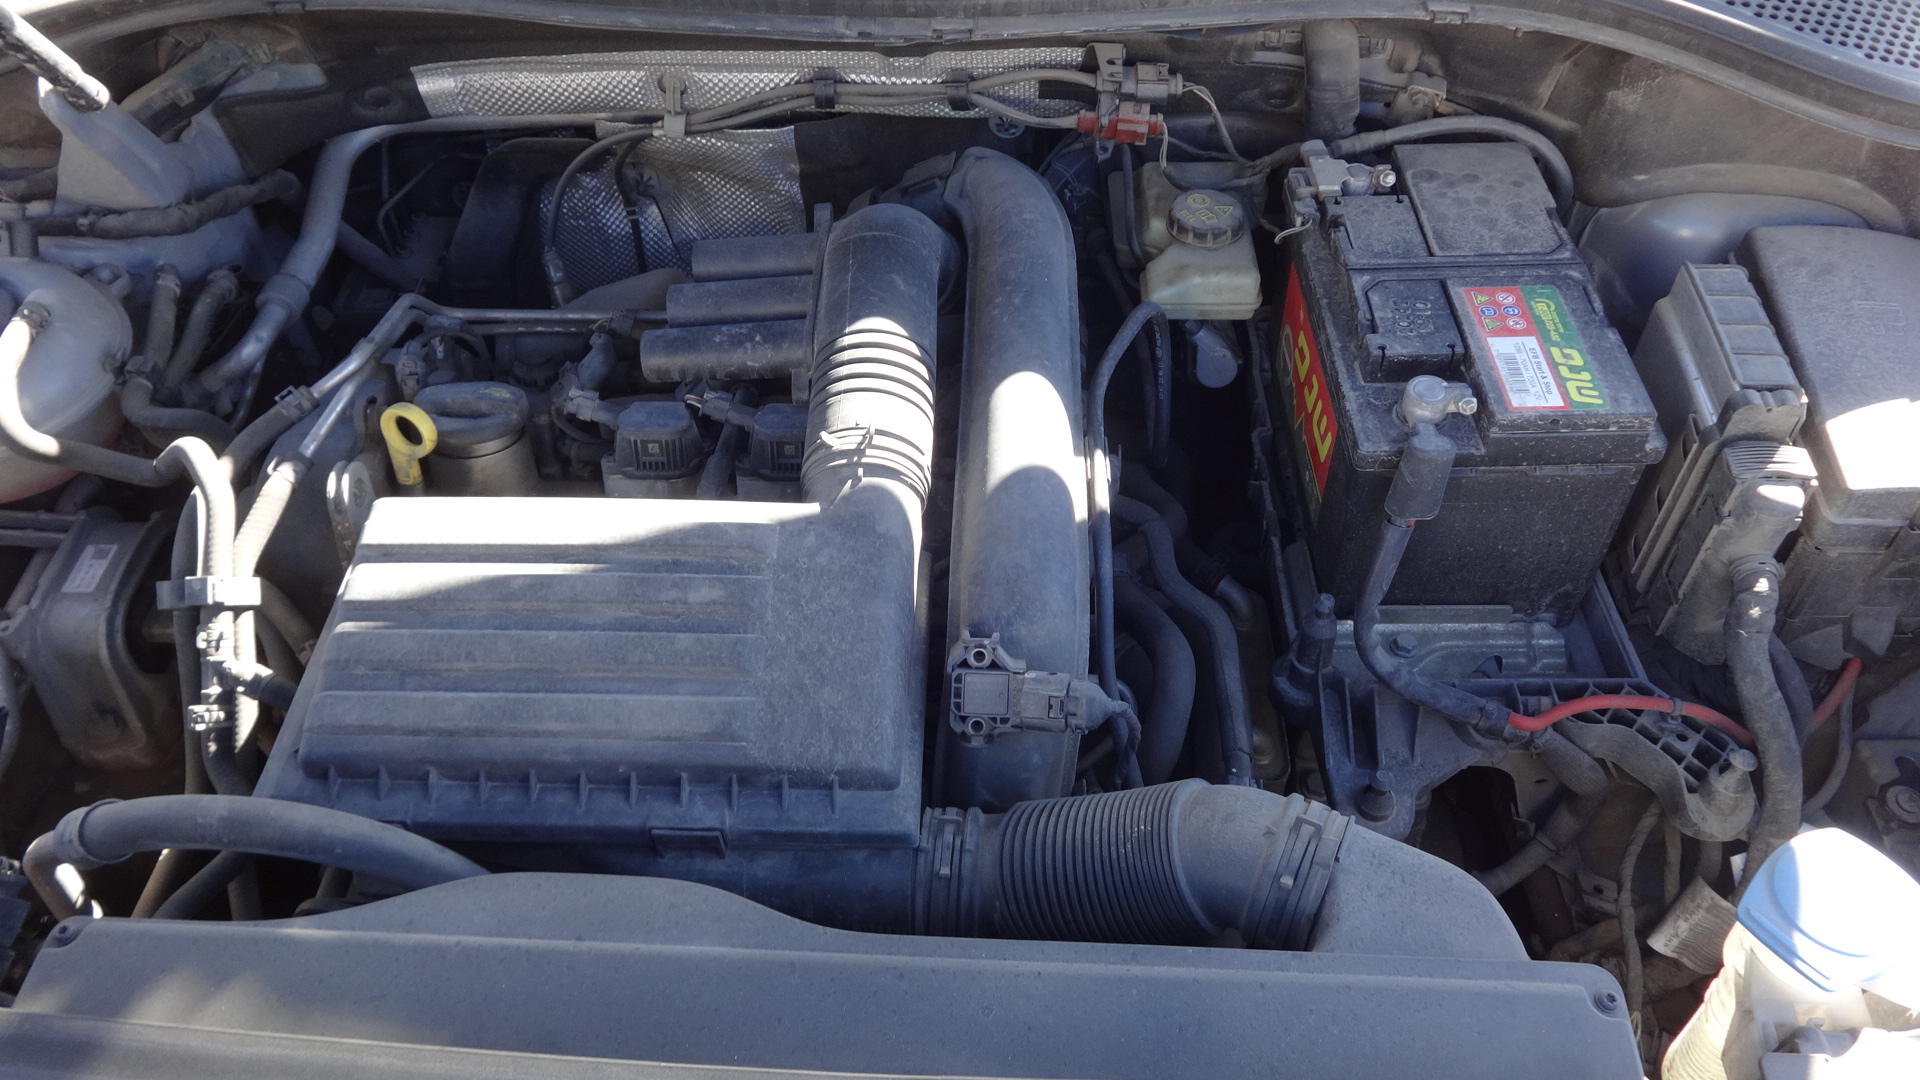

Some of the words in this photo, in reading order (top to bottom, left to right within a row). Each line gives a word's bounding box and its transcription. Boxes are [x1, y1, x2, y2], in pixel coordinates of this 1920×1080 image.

[1529, 347, 1540, 360] EFB
[1536, 360, 1545, 375] Start
[1543, 381, 1553, 395] Stop
